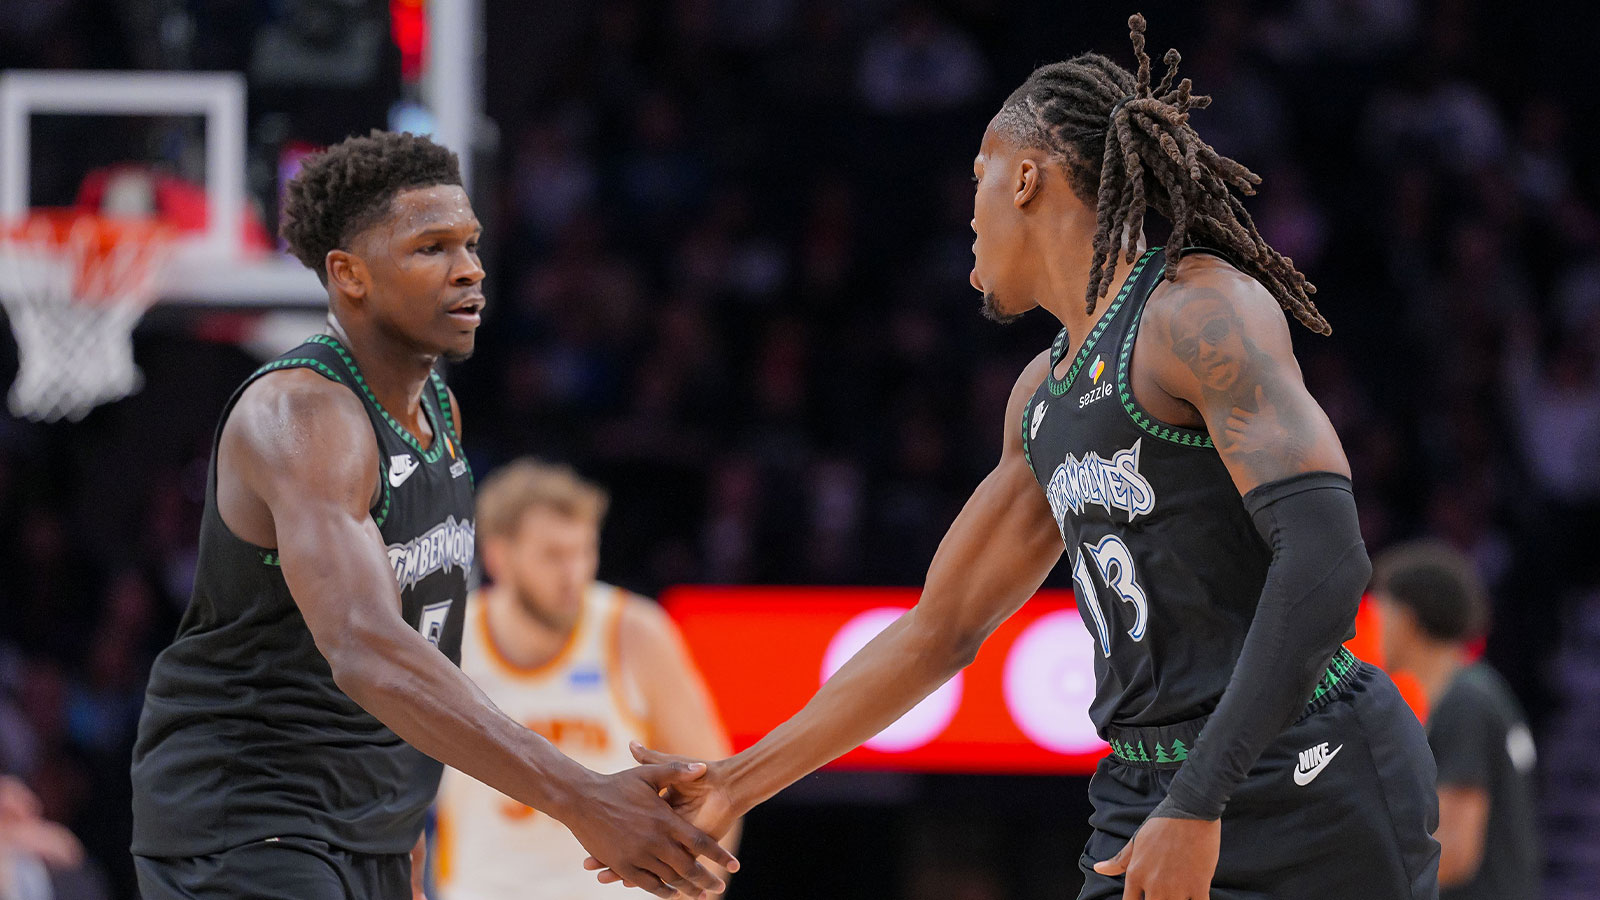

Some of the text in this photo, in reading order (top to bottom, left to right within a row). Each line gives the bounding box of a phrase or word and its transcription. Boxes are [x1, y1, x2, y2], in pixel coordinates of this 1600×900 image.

[1079, 381, 1113, 409] sezzle
[1072, 534, 1148, 658] 13
[1298, 741, 1329, 772] NIKE
